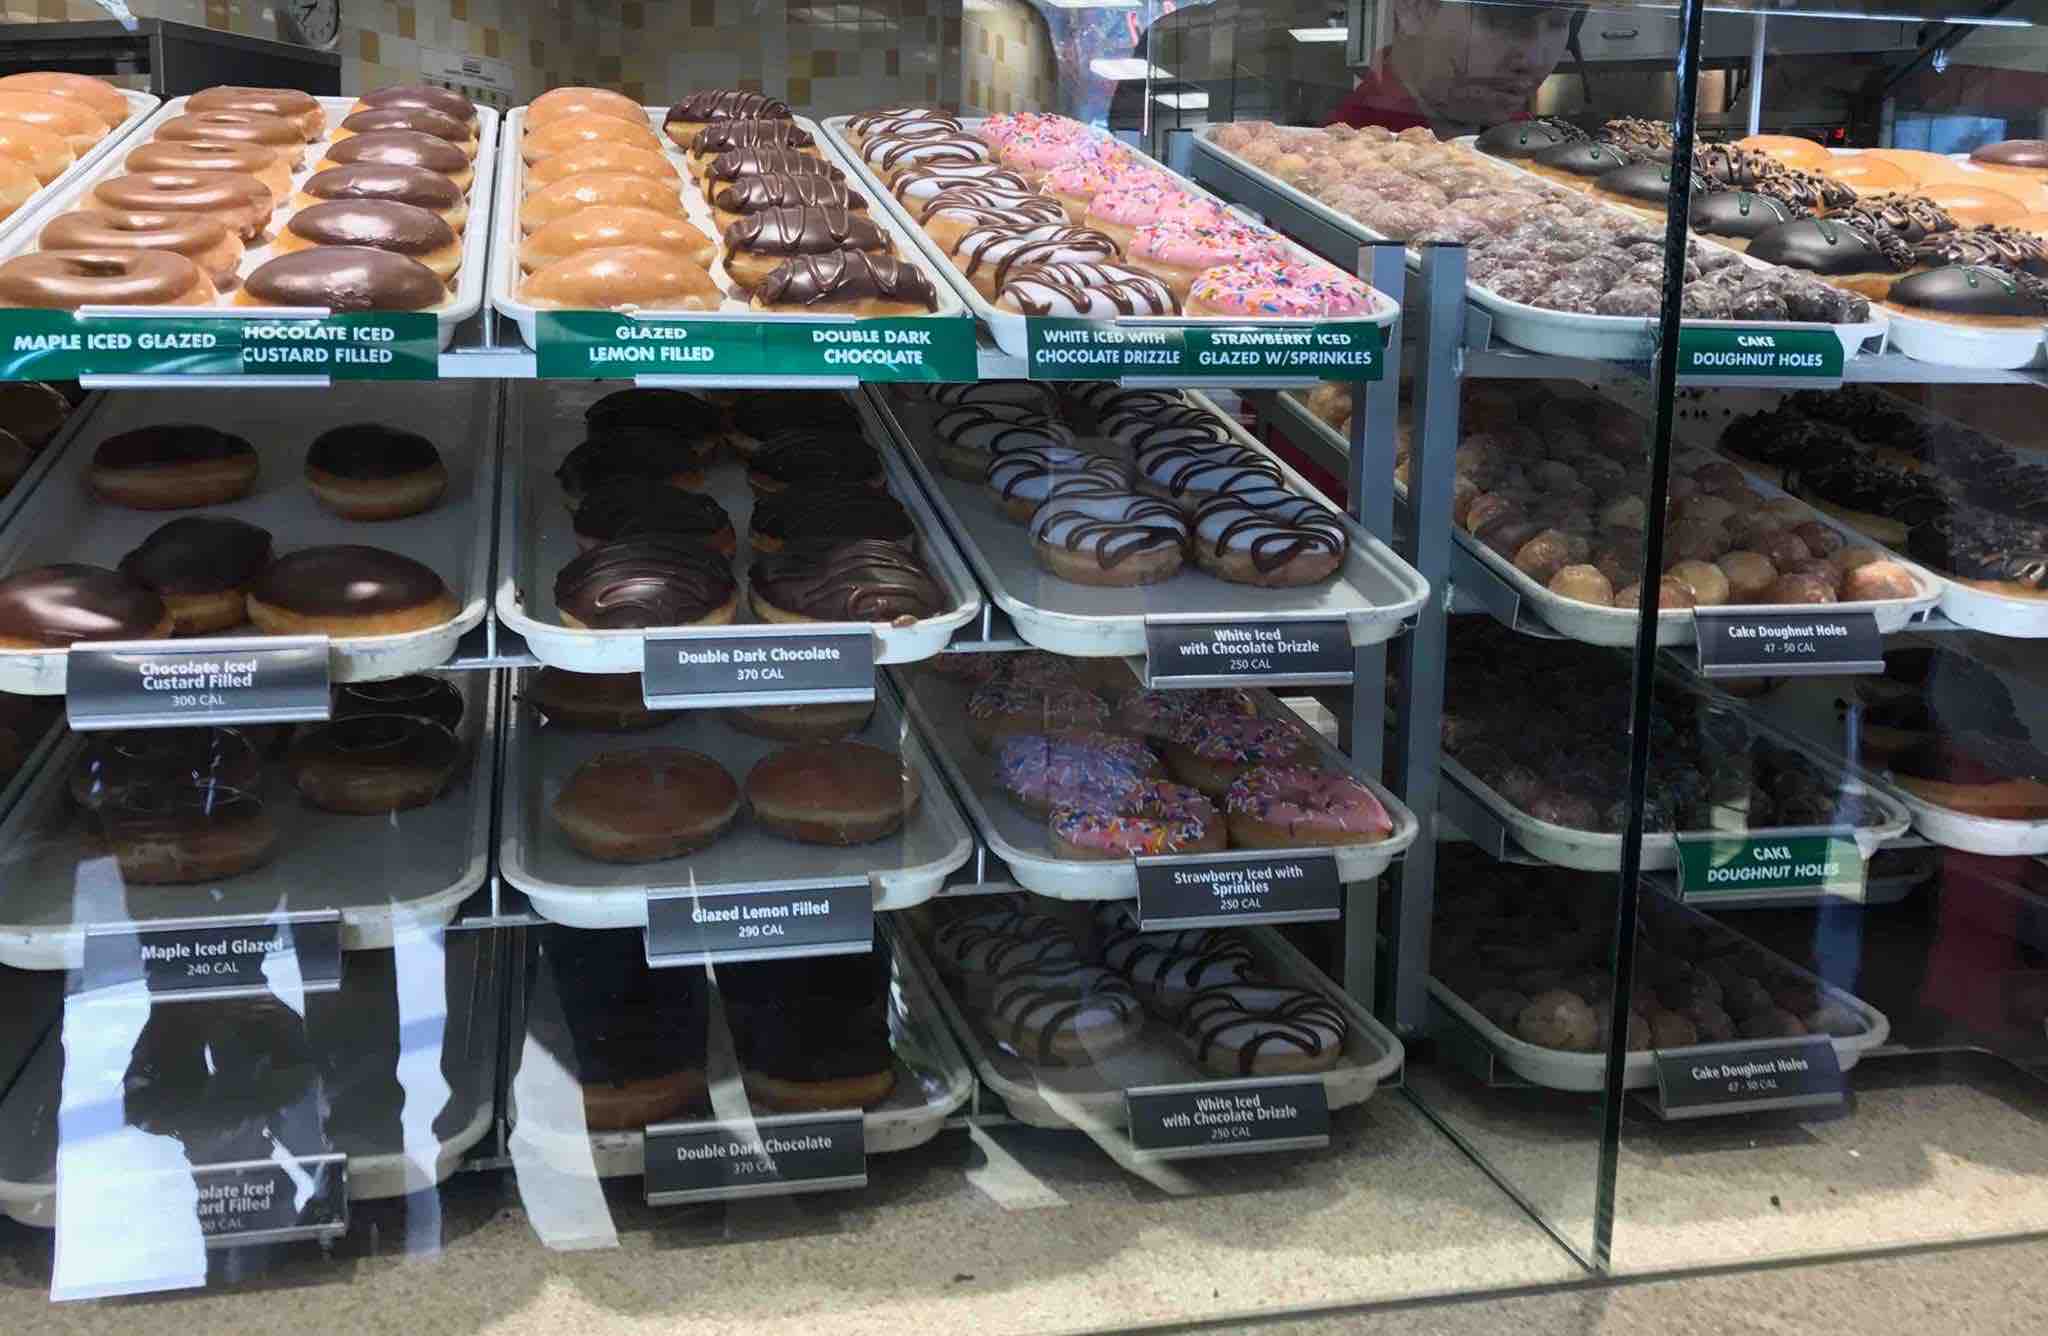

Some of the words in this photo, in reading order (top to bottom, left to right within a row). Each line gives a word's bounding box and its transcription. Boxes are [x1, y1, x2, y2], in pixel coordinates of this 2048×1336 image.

[240, 326, 346, 341] HOCOLATE
[353, 327, 394, 342] ICED
[616, 325, 687, 340] GLAZED
[812, 330, 880, 344] DOUBLE
[885, 330, 931, 344] DARK
[1043, 330, 1089, 343] WHITE
[1093, 331, 1124, 344] ICED
[1127, 332, 1165, 344] WITH
[1211, 333, 1312, 345] STRAWBERRY
[1317, 334, 1351, 345] ICED
[13, 334, 81, 351] MAPLE
[87, 334, 129, 350] ICED
[138, 333, 216, 349] GLAZED
[1737, 336, 1776, 347] CAKE
[242, 346, 328, 363] CUSTARD
[335, 347, 393, 364] FILLED
[589, 345, 655, 362] LEMON
[660, 346, 714, 362] FILLED
[824, 349, 923, 364] CHOCOLATE
[1036, 349, 1119, 364] CHOCOLATE
[1124, 350, 1180, 364] DRIZZLE
[1199, 351, 1260, 365] GLAZED
[1264, 351, 1372, 366] W/SPRINKLES
[1693, 352, 1775, 366] DOUGHNUT
[1779, 353, 1823, 367] HOLES
[1214, 630, 1252, 642] White
[1255, 628, 1281, 640] Iced
[1728, 626, 1756, 638] Cake
[1758, 625, 1813, 639] Doughnut
[1818, 624, 1848, 636] Holes
[678, 650, 729, 664] Double
[734, 648, 767, 662] Dark
[771, 647, 840, 661] Chocolate
[1180, 643, 1209, 656] with
[1212, 641, 1274, 654] Chocolate
[1278, 640, 1320, 653] Drizzle
[1797, 643, 1816, 653] CAL
[139, 661, 219, 676] Chocolate
[225, 658, 257, 673] Iced
[1230, 660, 1249, 670] 250
[1251, 659, 1272, 668] CAL
[737, 669, 758, 681] 370
[761, 668, 784, 679] CAL
[143, 676, 205, 691] Custard
[209, 674, 252, 688] Filled
[171, 695, 195, 707] 300
[200, 695, 225, 705] CAL
[1753, 847, 1792, 861] CAKE
[1174, 869, 1243, 885] Strawberry
[1247, 866, 1272, 880] Iced
[1275, 864, 1303, 879] with
[1707, 866, 1791, 882] DOUGHNUT
[1794, 863, 1839, 877] HOLES
[1213, 882, 1269, 897] Sprinkles
[1241, 898, 1262, 908] CAL
[692, 906, 739, 923] Glazed
[743, 905, 789, 919] Lemon
[793, 900, 829, 917] Filled
[738, 925, 759, 937] 290
[762, 924, 784, 936] CAL
[141, 943, 191, 960] Maple
[196, 941, 227, 956] Iced
[187, 964, 210, 976] 240
[214, 963, 239, 974] CAL
[1691, 1066, 1720, 1081] Cake
[1722, 1061, 1776, 1078] Doughnut
[1196, 1097, 1232, 1112] White
[1236, 1094, 1261, 1108] Iced
[1162, 1114, 1190, 1128] with
[1194, 1110, 1254, 1125] Chocolate
[1257, 1105, 1297, 1120] Drizzle
[677, 1145, 726, 1161] Double
[766, 1136, 832, 1153] Chocolate
[757, 1160, 777, 1172] CAL
[244, 1180, 274, 1196] Iced
[229, 1198, 270, 1213] Filled
